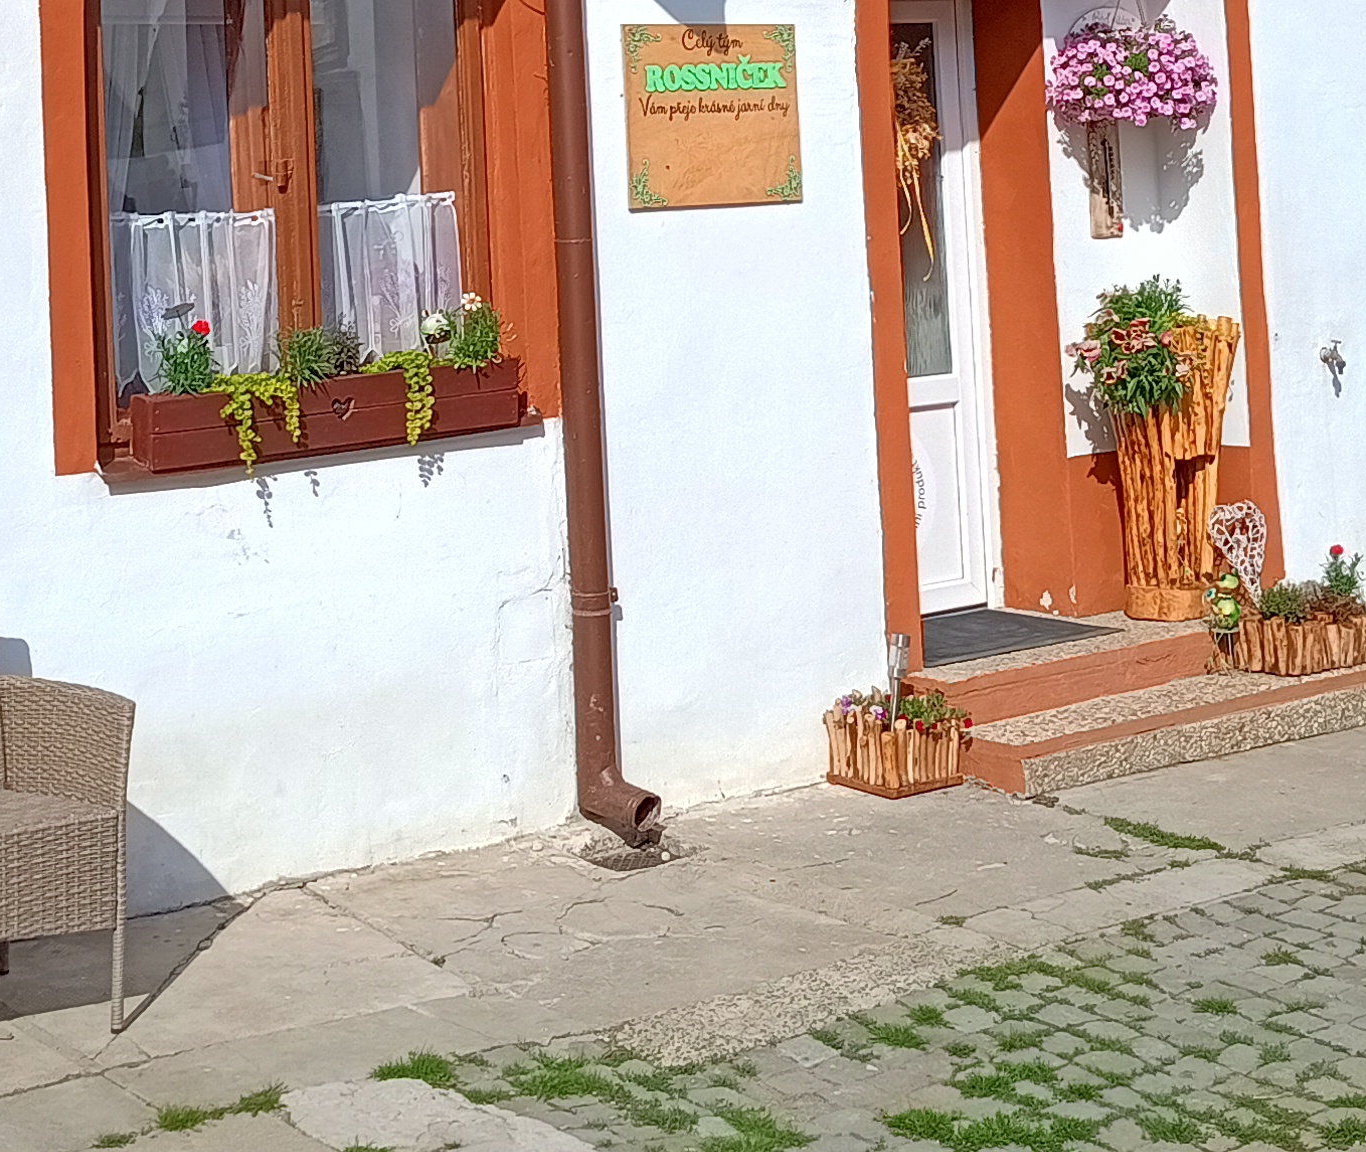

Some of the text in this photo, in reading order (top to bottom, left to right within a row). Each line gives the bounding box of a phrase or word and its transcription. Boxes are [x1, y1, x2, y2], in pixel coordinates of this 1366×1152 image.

[681, 28, 744, 56] Celý tým
[644, 54, 787, 93] ROSSNIČEK
[638, 93, 669, 117] Vám
[767, 95, 791, 118] dny
